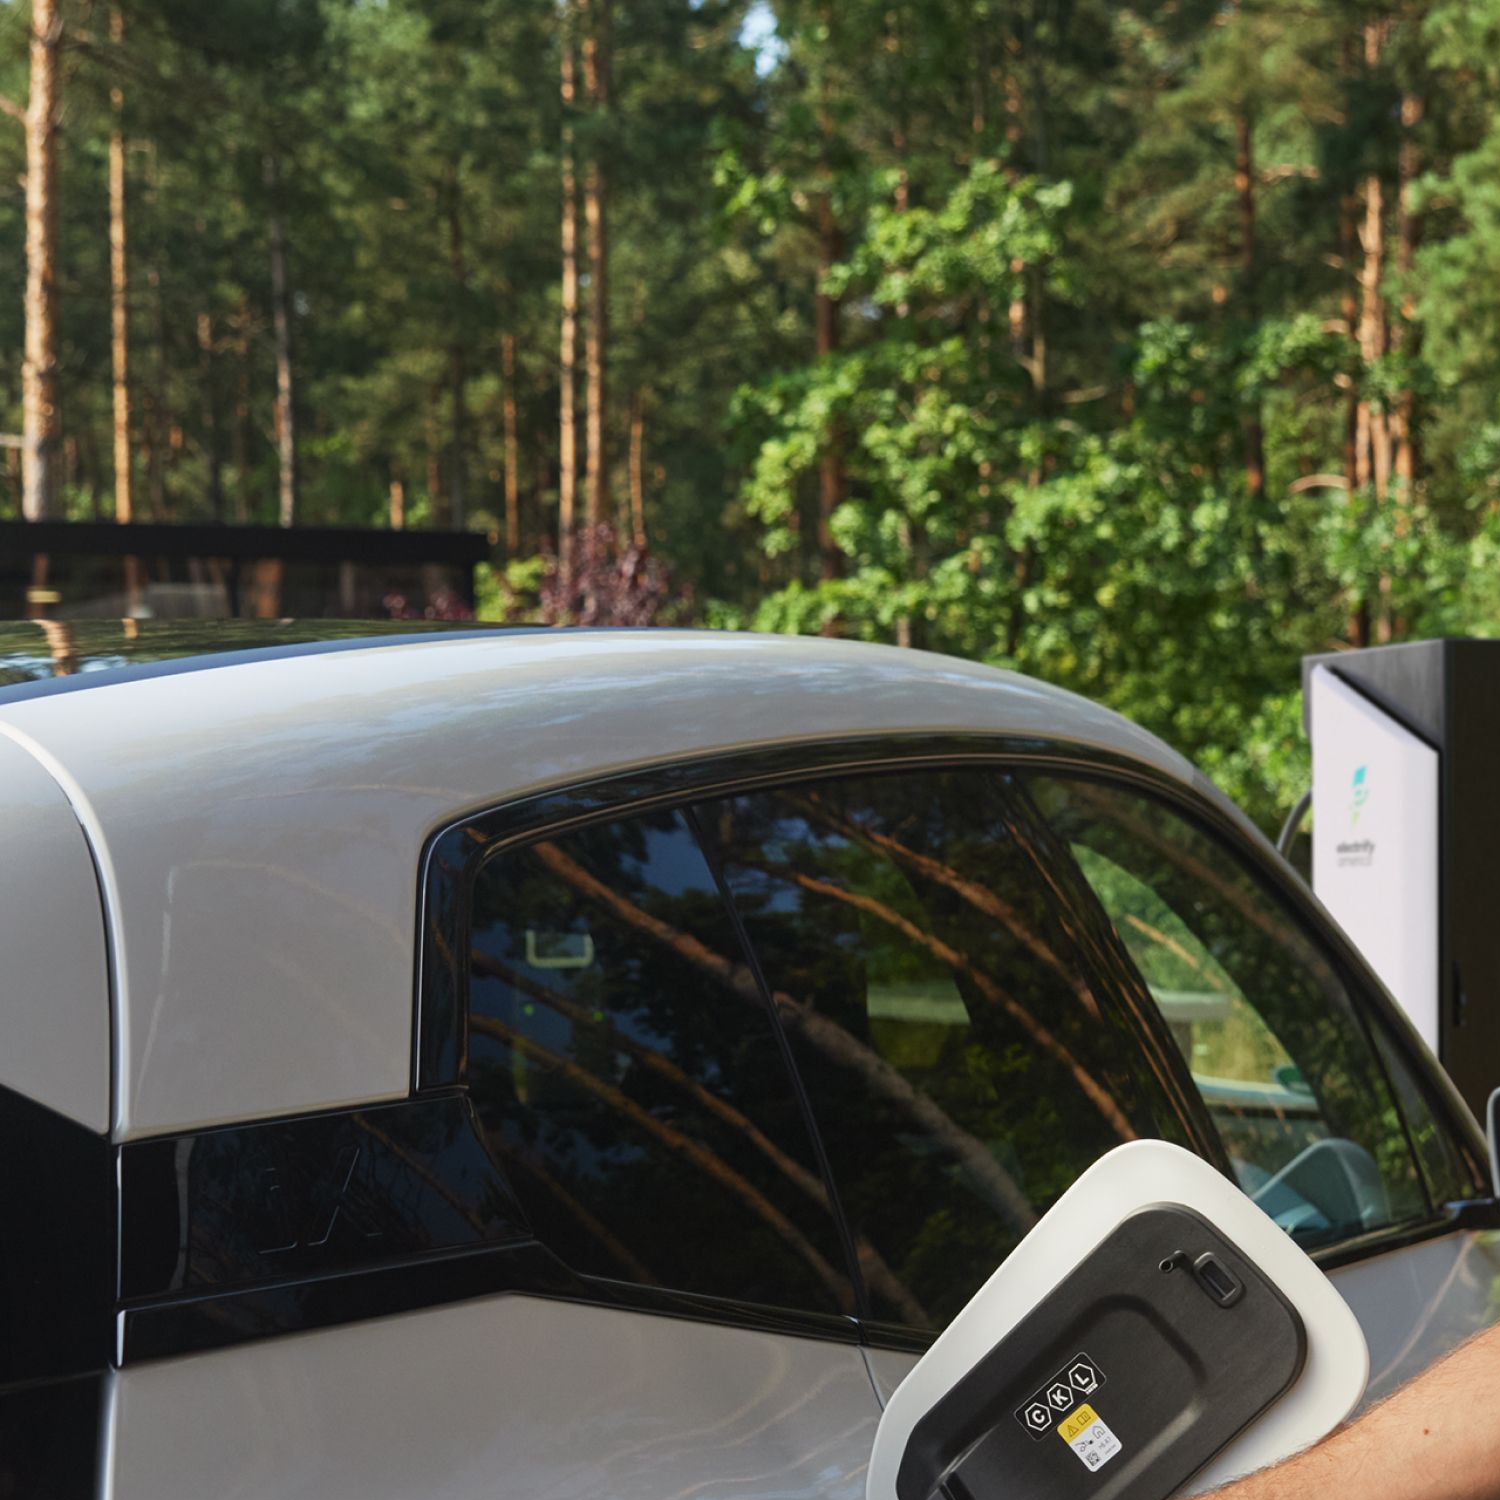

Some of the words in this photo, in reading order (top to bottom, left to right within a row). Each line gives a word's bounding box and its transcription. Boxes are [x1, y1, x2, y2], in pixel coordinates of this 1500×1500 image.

[1032, 1410, 1045, 1424] C
[1052, 1389, 1069, 1406] K
[1074, 1373, 1090, 1385] L
